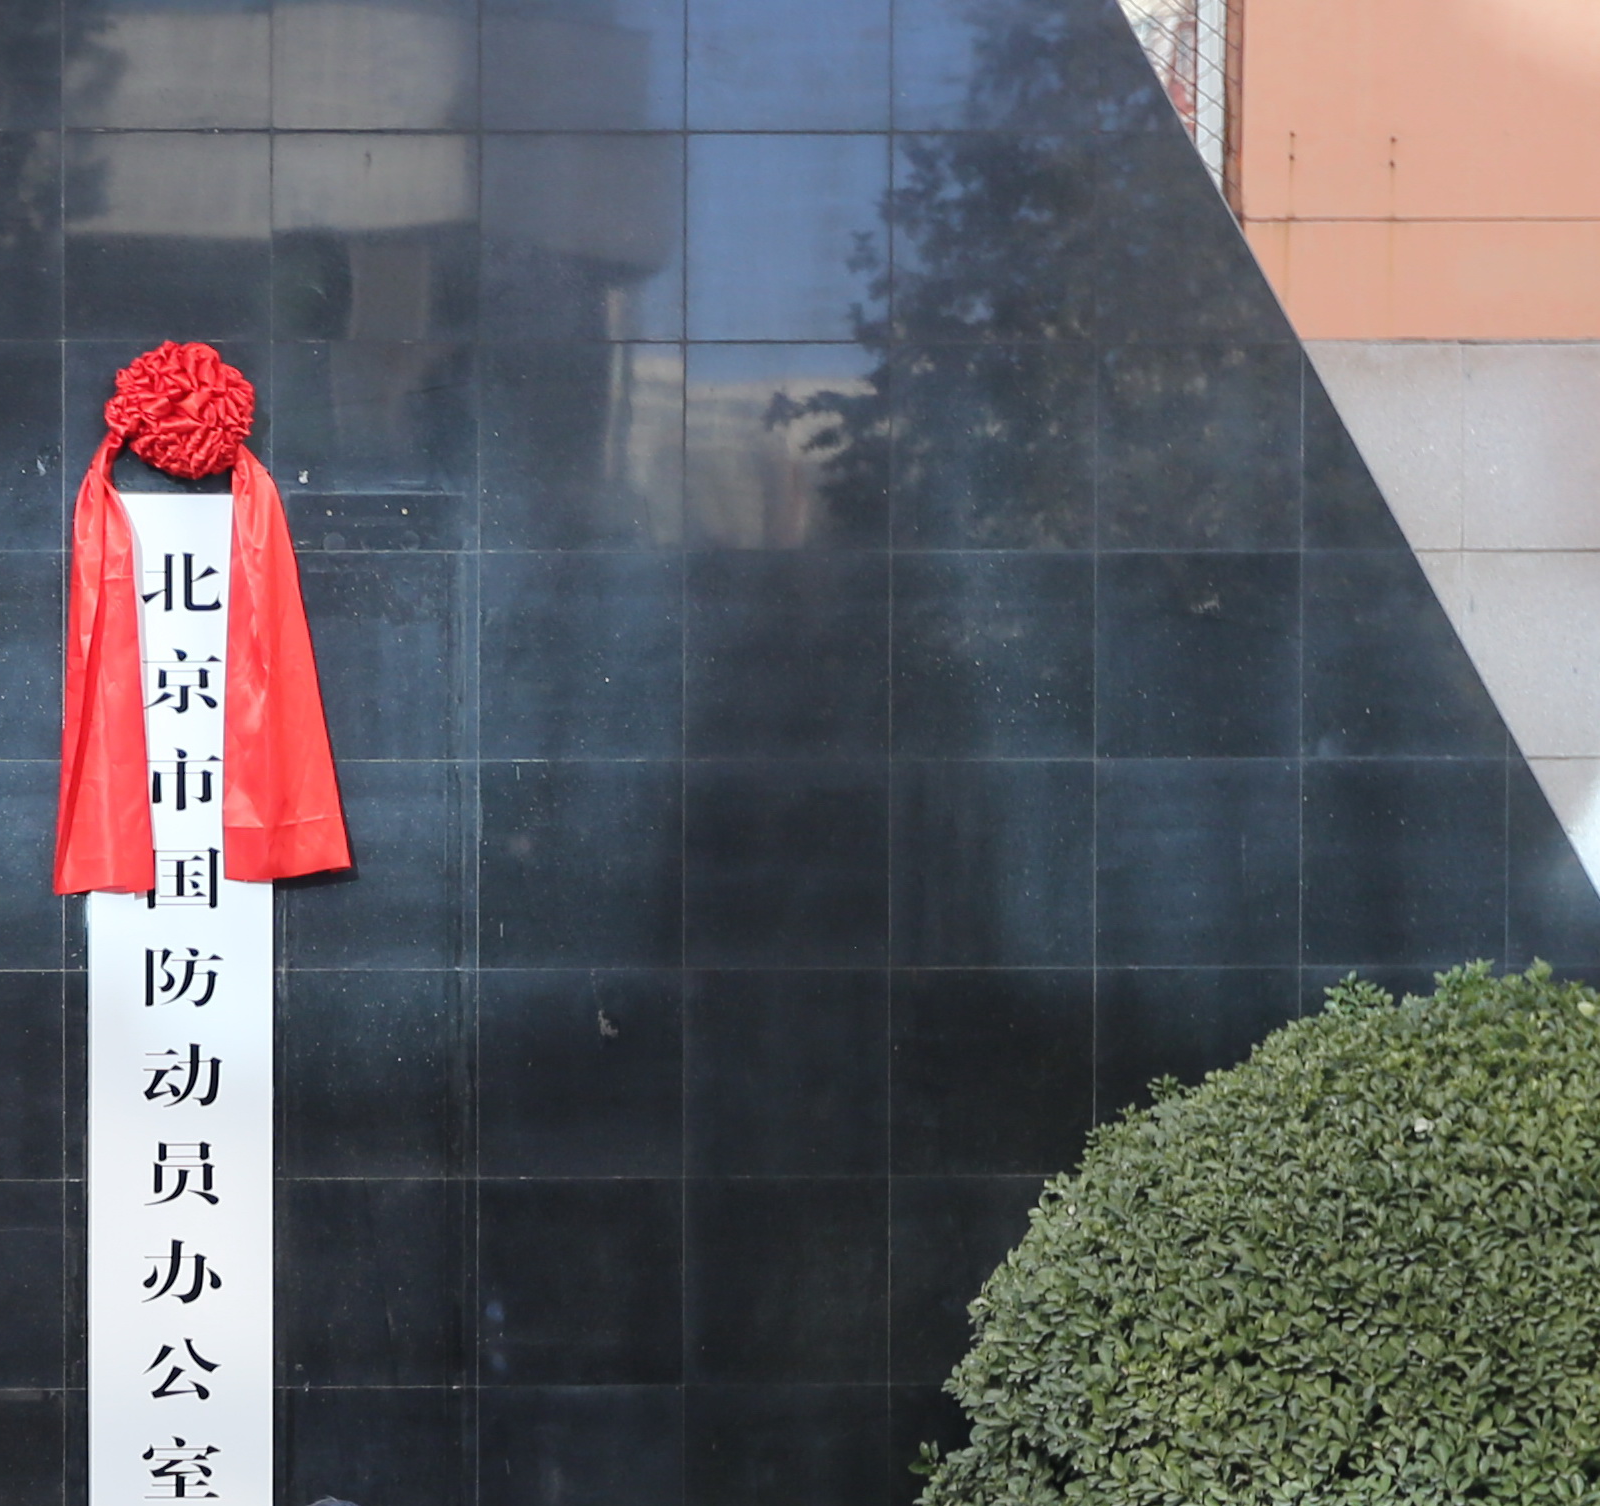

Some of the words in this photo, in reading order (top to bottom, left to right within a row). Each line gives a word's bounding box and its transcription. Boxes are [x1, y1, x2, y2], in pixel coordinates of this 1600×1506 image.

[140, 552, 225, 1500] 北京市国防动员办公室
